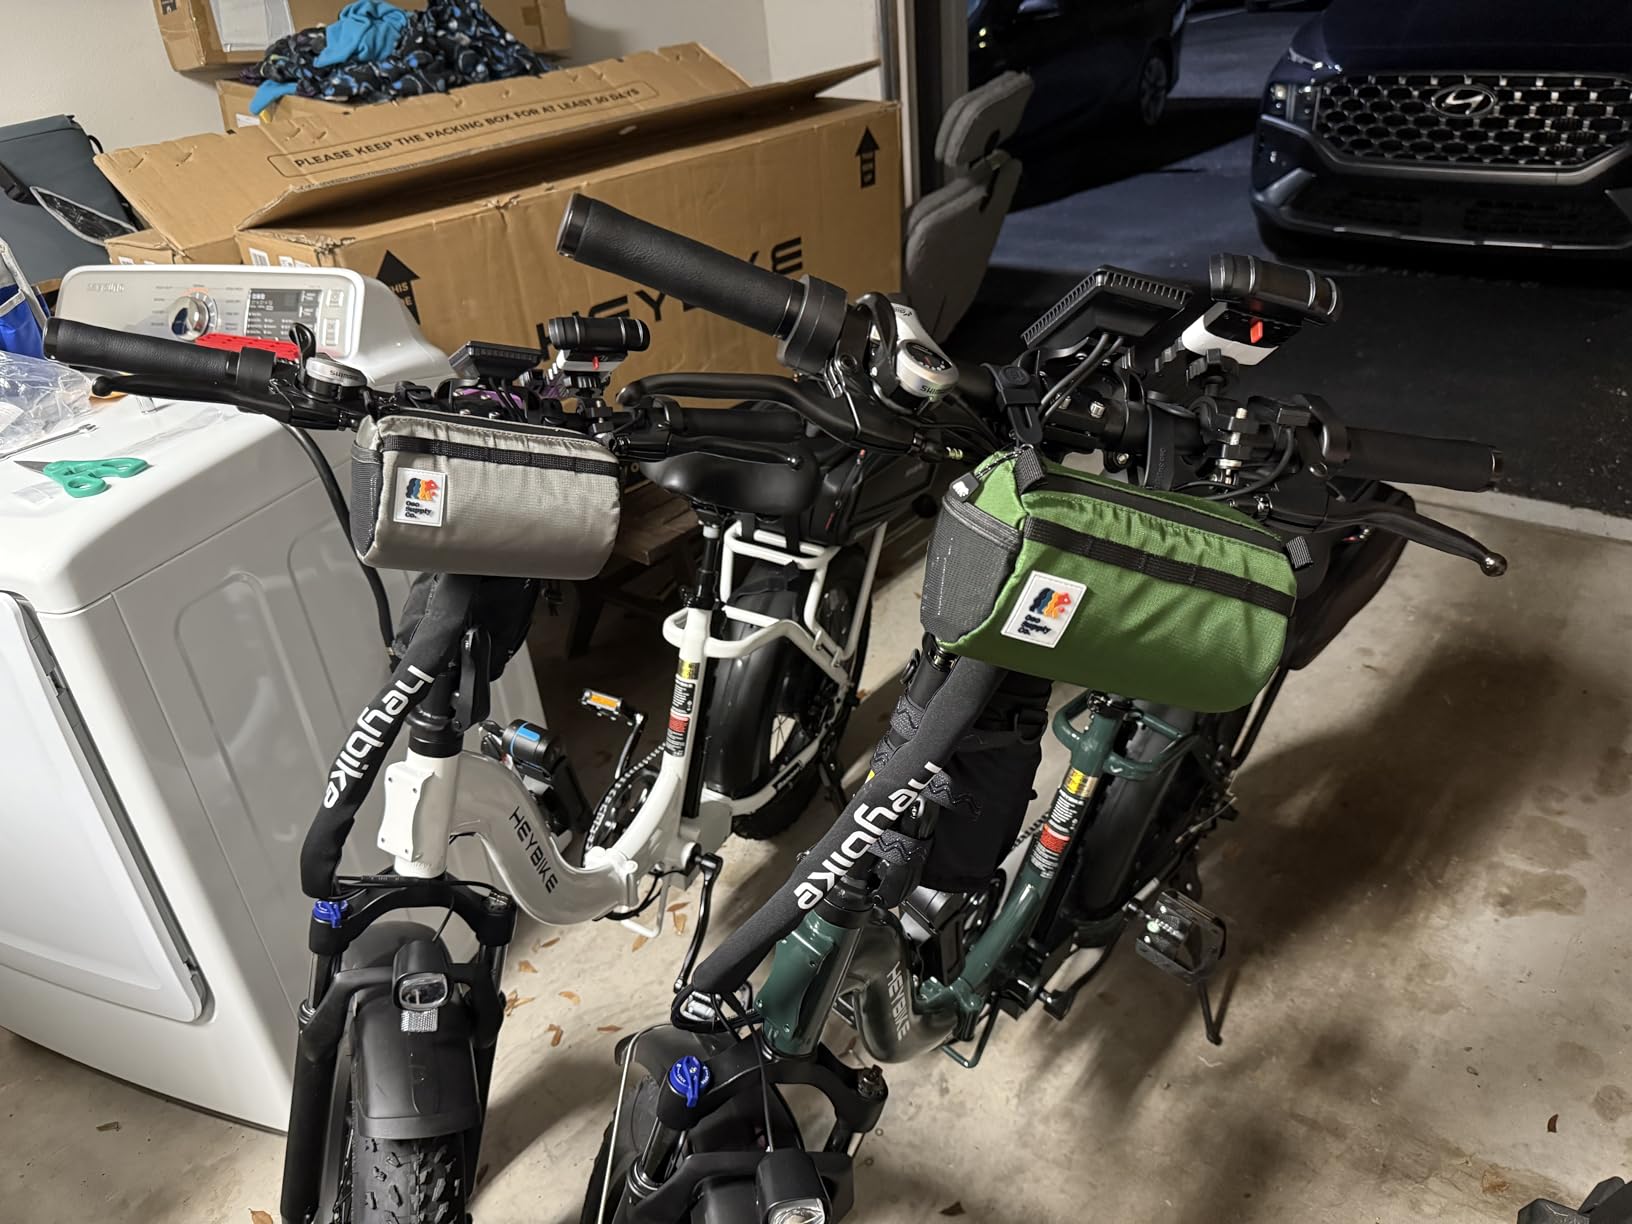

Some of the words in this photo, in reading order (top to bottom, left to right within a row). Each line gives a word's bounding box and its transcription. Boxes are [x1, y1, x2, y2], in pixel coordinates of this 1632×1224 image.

[294, 151, 354, 168] PLEASE
[354, 141, 393, 155] KEEP
[394, 134, 424, 146] THE
[427, 119, 484, 140] PACKING
[485, 113, 514, 125] BOX
[514, 108, 539, 119] FOR
[542, 105, 557, 114] AT
[558, 98, 594, 111] LEAST
[610, 88, 641, 101] DAYS
[323, 664, 435, 809] heybike
[509, 806, 558, 894] HEYBIKE
[886, 960, 911, 1040] HEYBIKE
